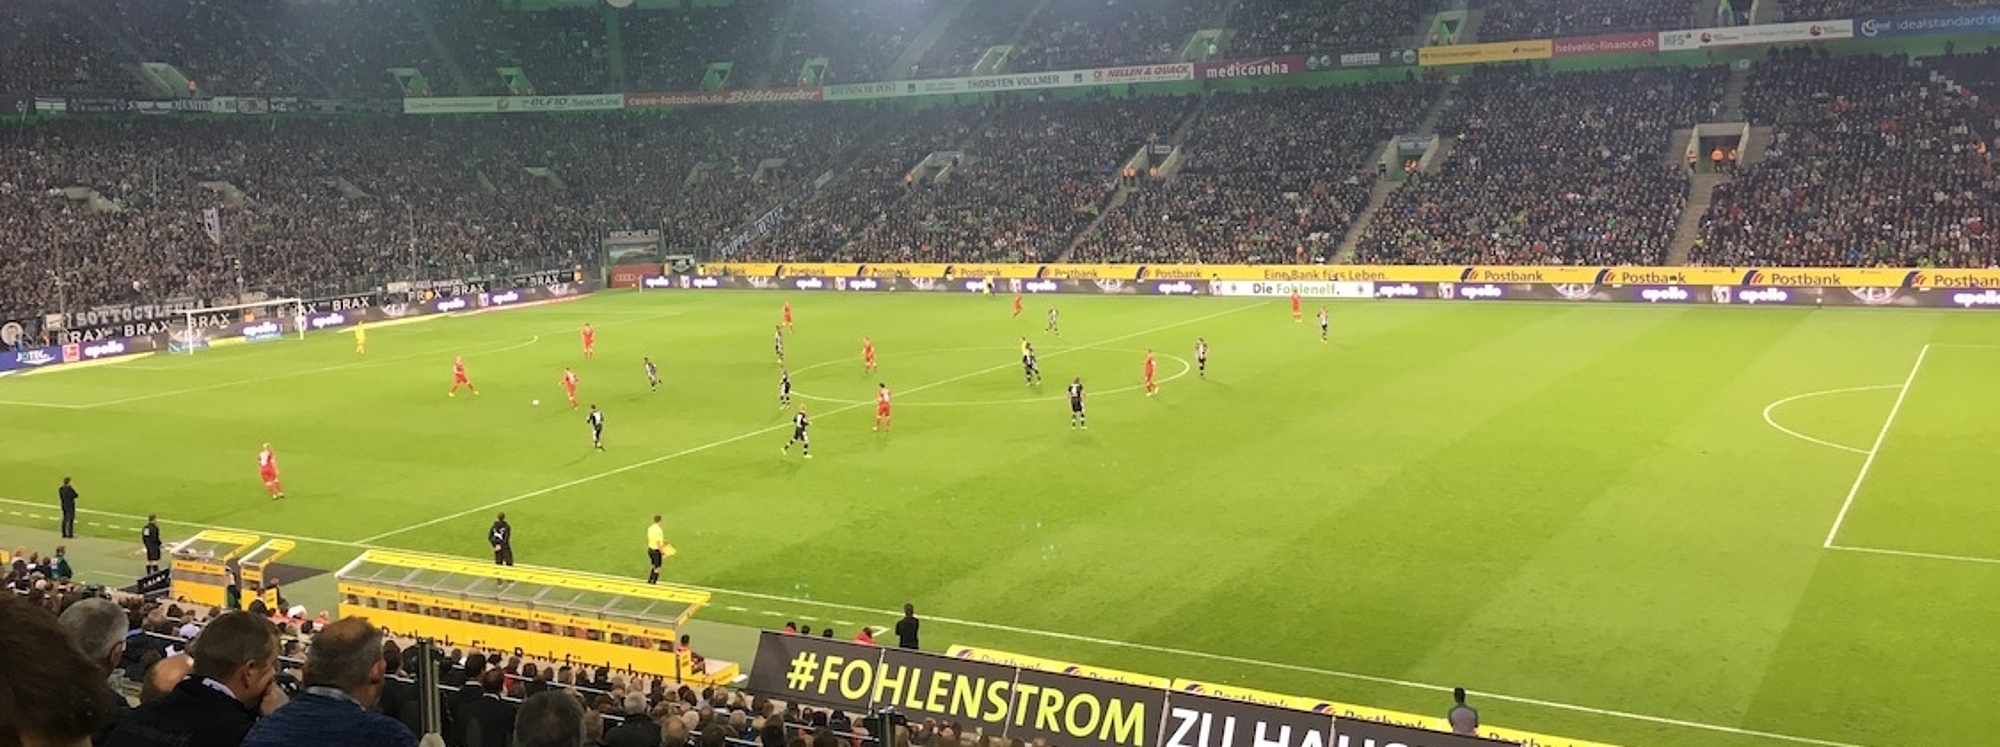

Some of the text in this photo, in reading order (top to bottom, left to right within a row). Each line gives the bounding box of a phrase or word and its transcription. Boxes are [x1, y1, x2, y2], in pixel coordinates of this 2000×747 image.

[1555, 38, 1655, 56] helvetic-finance.ch
[1206, 61, 1289, 80] medicoreha
[967, 77, 1014, 90] THORSTEN
[1016, 74, 1060, 87] VOLLMER
[1154, 268, 1203, 280] Postbank
[1264, 269, 1291, 281] Eine
[1291, 269, 1320, 281] Bank
[1484, 269, 1544, 282] Postbank
[1771, 272, 1842, 286] Postbank
[1252, 282, 1273, 295] Die
[1379, 282, 1419, 299] apollo
[1460, 283, 1502, 300] apollo
[1641, 285, 1689, 303] apollo
[1738, 286, 1789, 305] apollo
[331, 295, 371, 313] BRAX
[123, 319, 171, 338] BRAX
[786, 650, 1146, 747] #FOHLENSTROM
